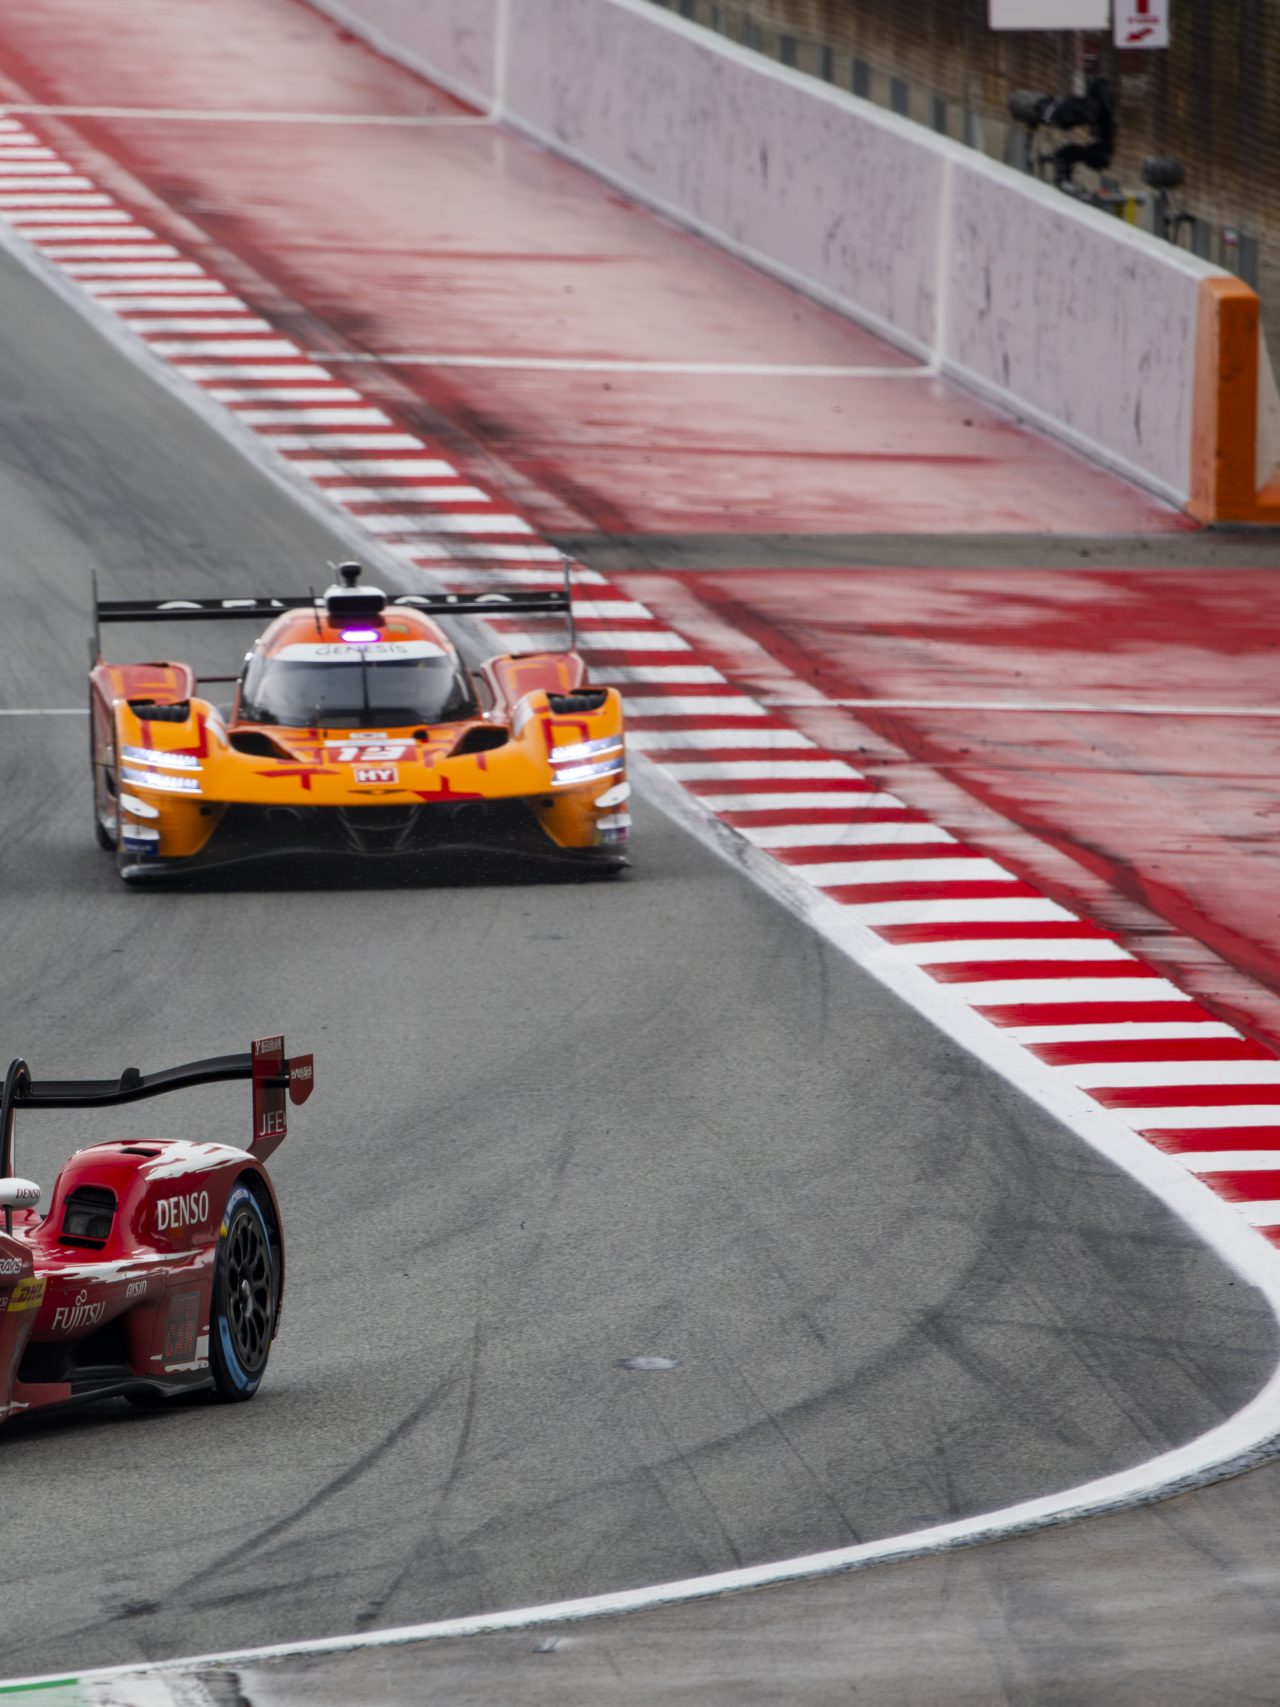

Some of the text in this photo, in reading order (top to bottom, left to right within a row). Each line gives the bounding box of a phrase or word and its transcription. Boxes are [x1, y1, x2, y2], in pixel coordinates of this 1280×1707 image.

[357, 769, 392, 781] HY
[157, 1190, 209, 1231] DENSO
[125, 1280, 148, 1299] AISIN
[51, 1301, 106, 1335] FUJITSU
